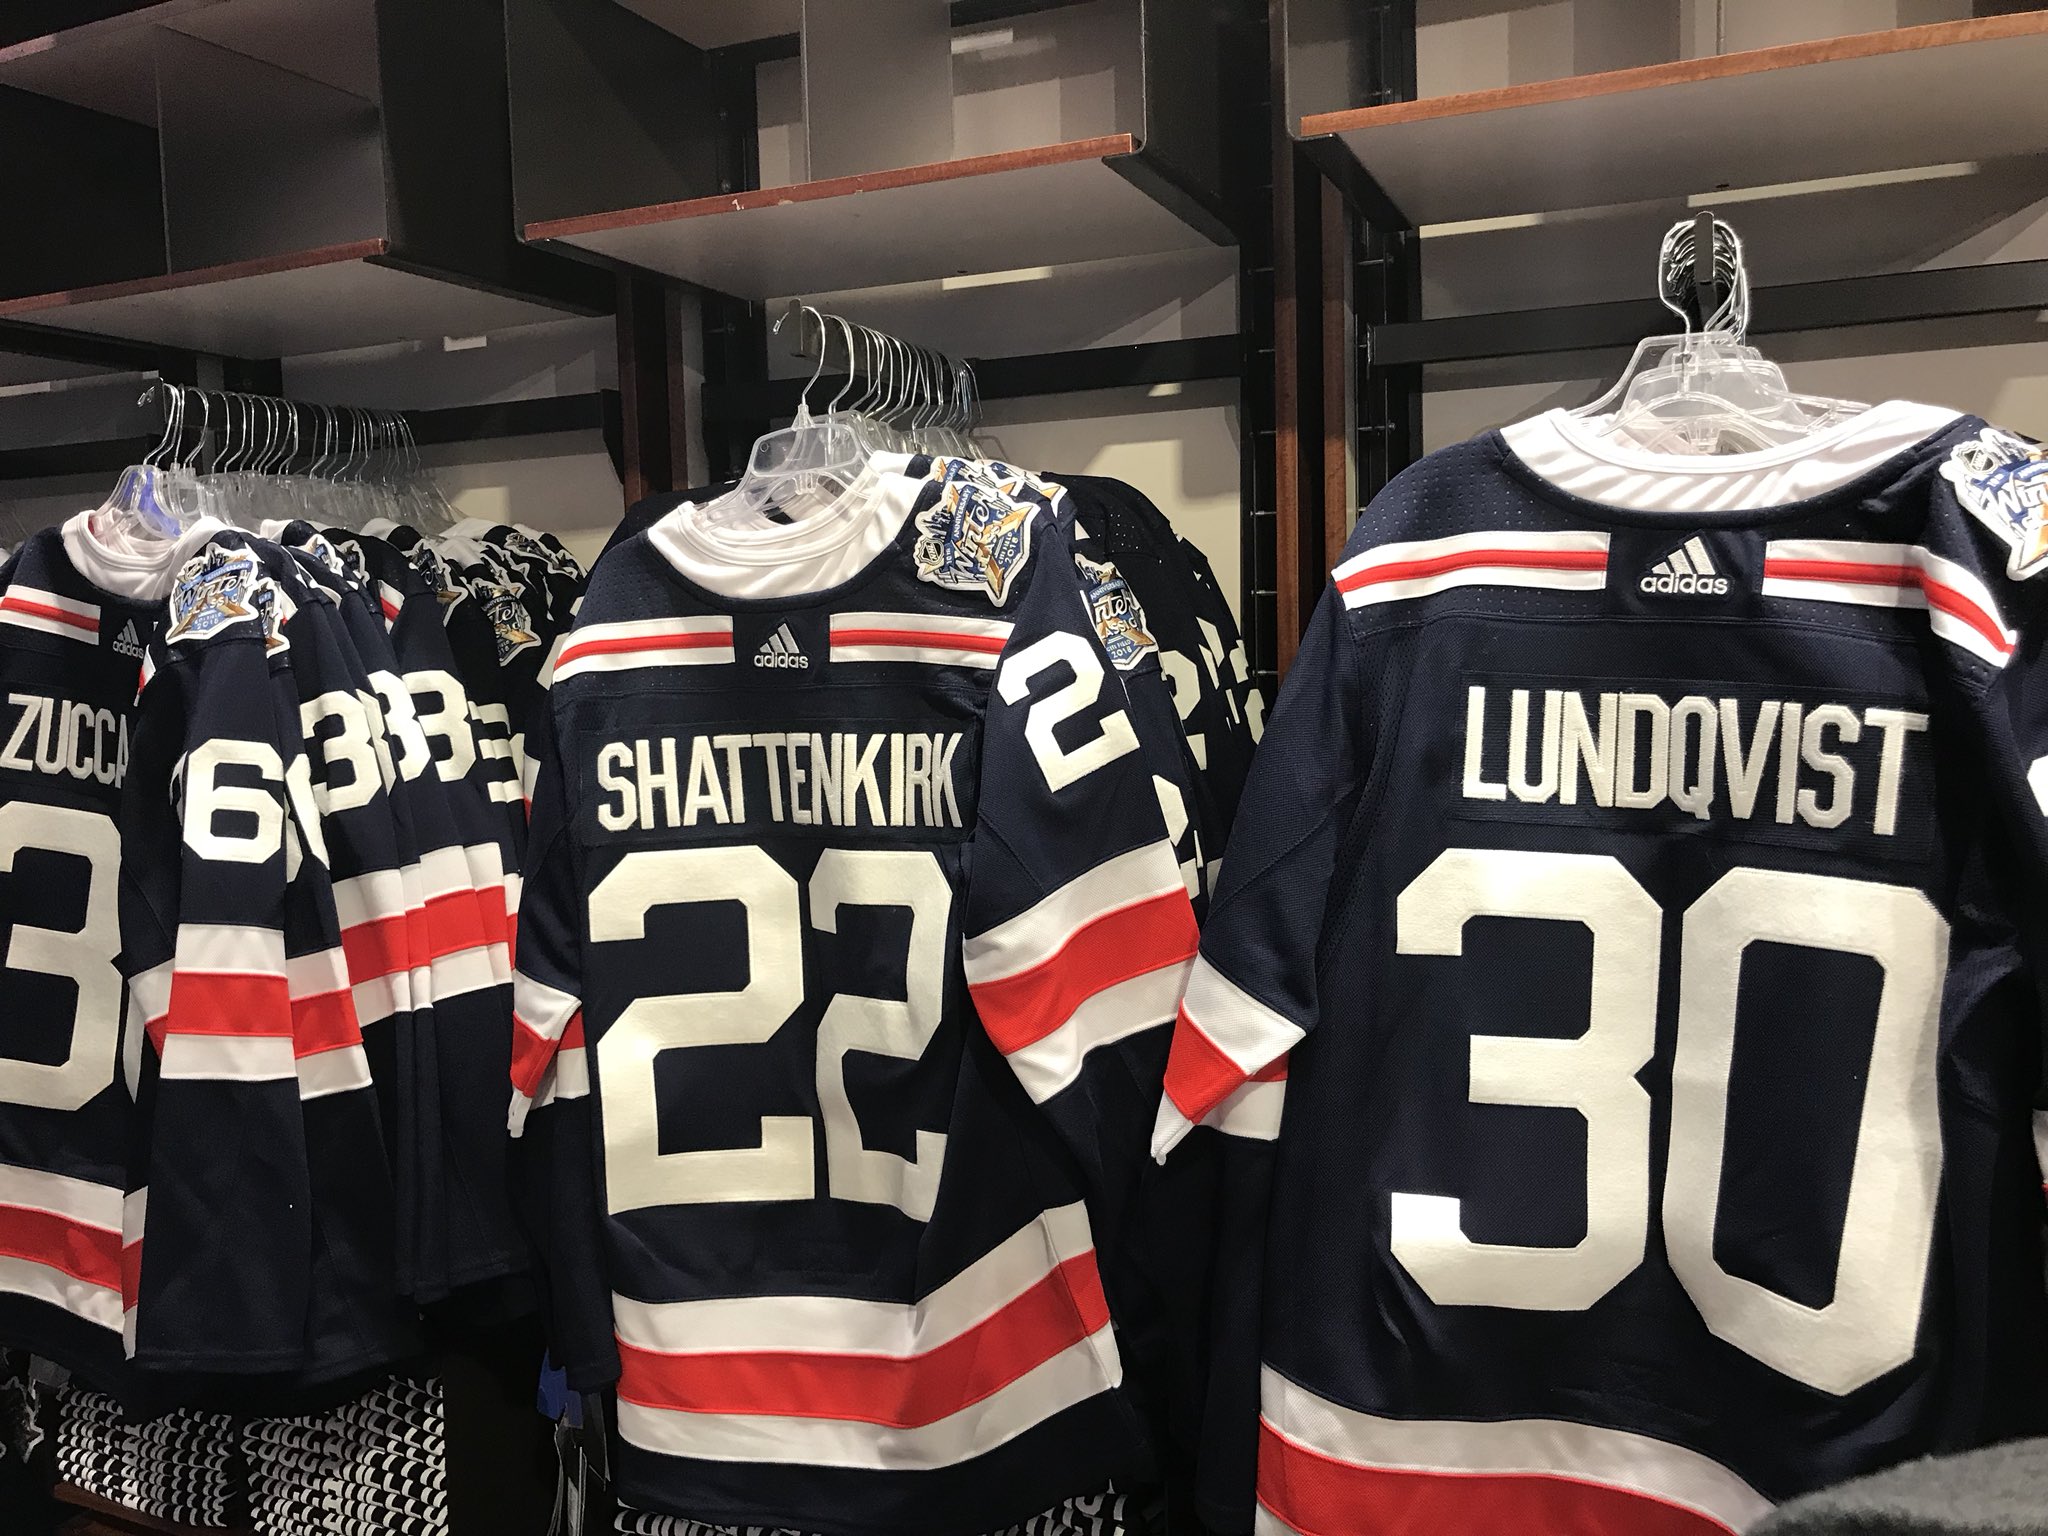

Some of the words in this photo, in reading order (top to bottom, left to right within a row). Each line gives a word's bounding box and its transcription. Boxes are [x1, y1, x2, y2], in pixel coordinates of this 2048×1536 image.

[949, 497, 990, 583] Winter
[953, 488, 972, 538] ANNIVERSARY
[977, 509, 1007, 572] CLASSIC
[1004, 537, 1019, 564] 2018
[1640, 572, 1729, 595] adidas
[112, 640, 144, 659] adidas
[753, 652, 809, 669] adidas
[1111, 646, 1133, 659] 2018
[997, 631, 1140, 794] 2
[597, 732, 964, 831] SHATTENKIRK
[1462, 686, 1930, 836] LUNDQVIST
[183, 738, 284, 864] 6
[588, 845, 953, 1222] 22
[1391, 848, 1951, 1397] 30
